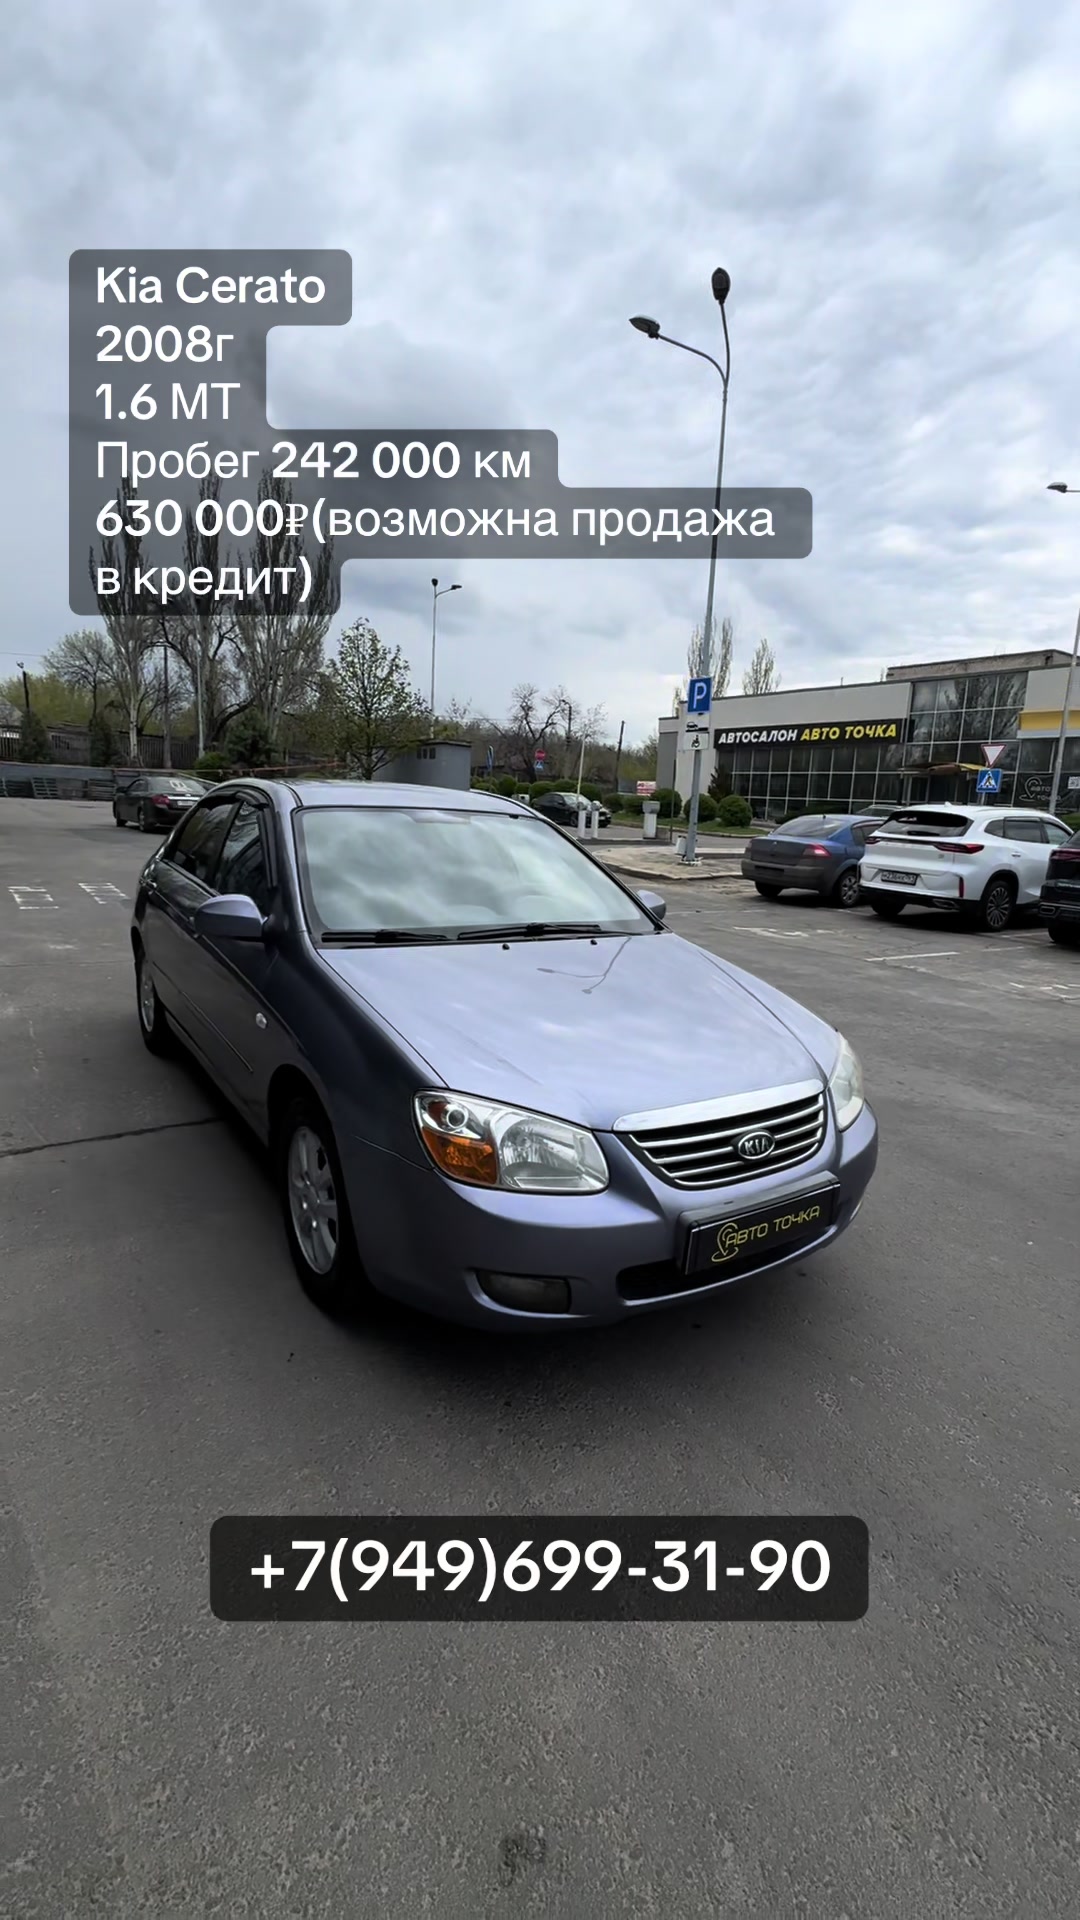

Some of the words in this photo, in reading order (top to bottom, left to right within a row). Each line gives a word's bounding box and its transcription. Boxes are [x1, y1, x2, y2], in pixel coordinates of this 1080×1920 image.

[693, 682, 707, 709] P
[718, 729, 798, 744] АВТОСАЛОН
[800, 726, 840, 741] АВТО
[844, 724, 897, 739] ТОЧКА
[744, 1138, 771, 1155] KIA
[725, 1223, 769, 1247] АВТО
[774, 1205, 821, 1231] ТОЧКА
